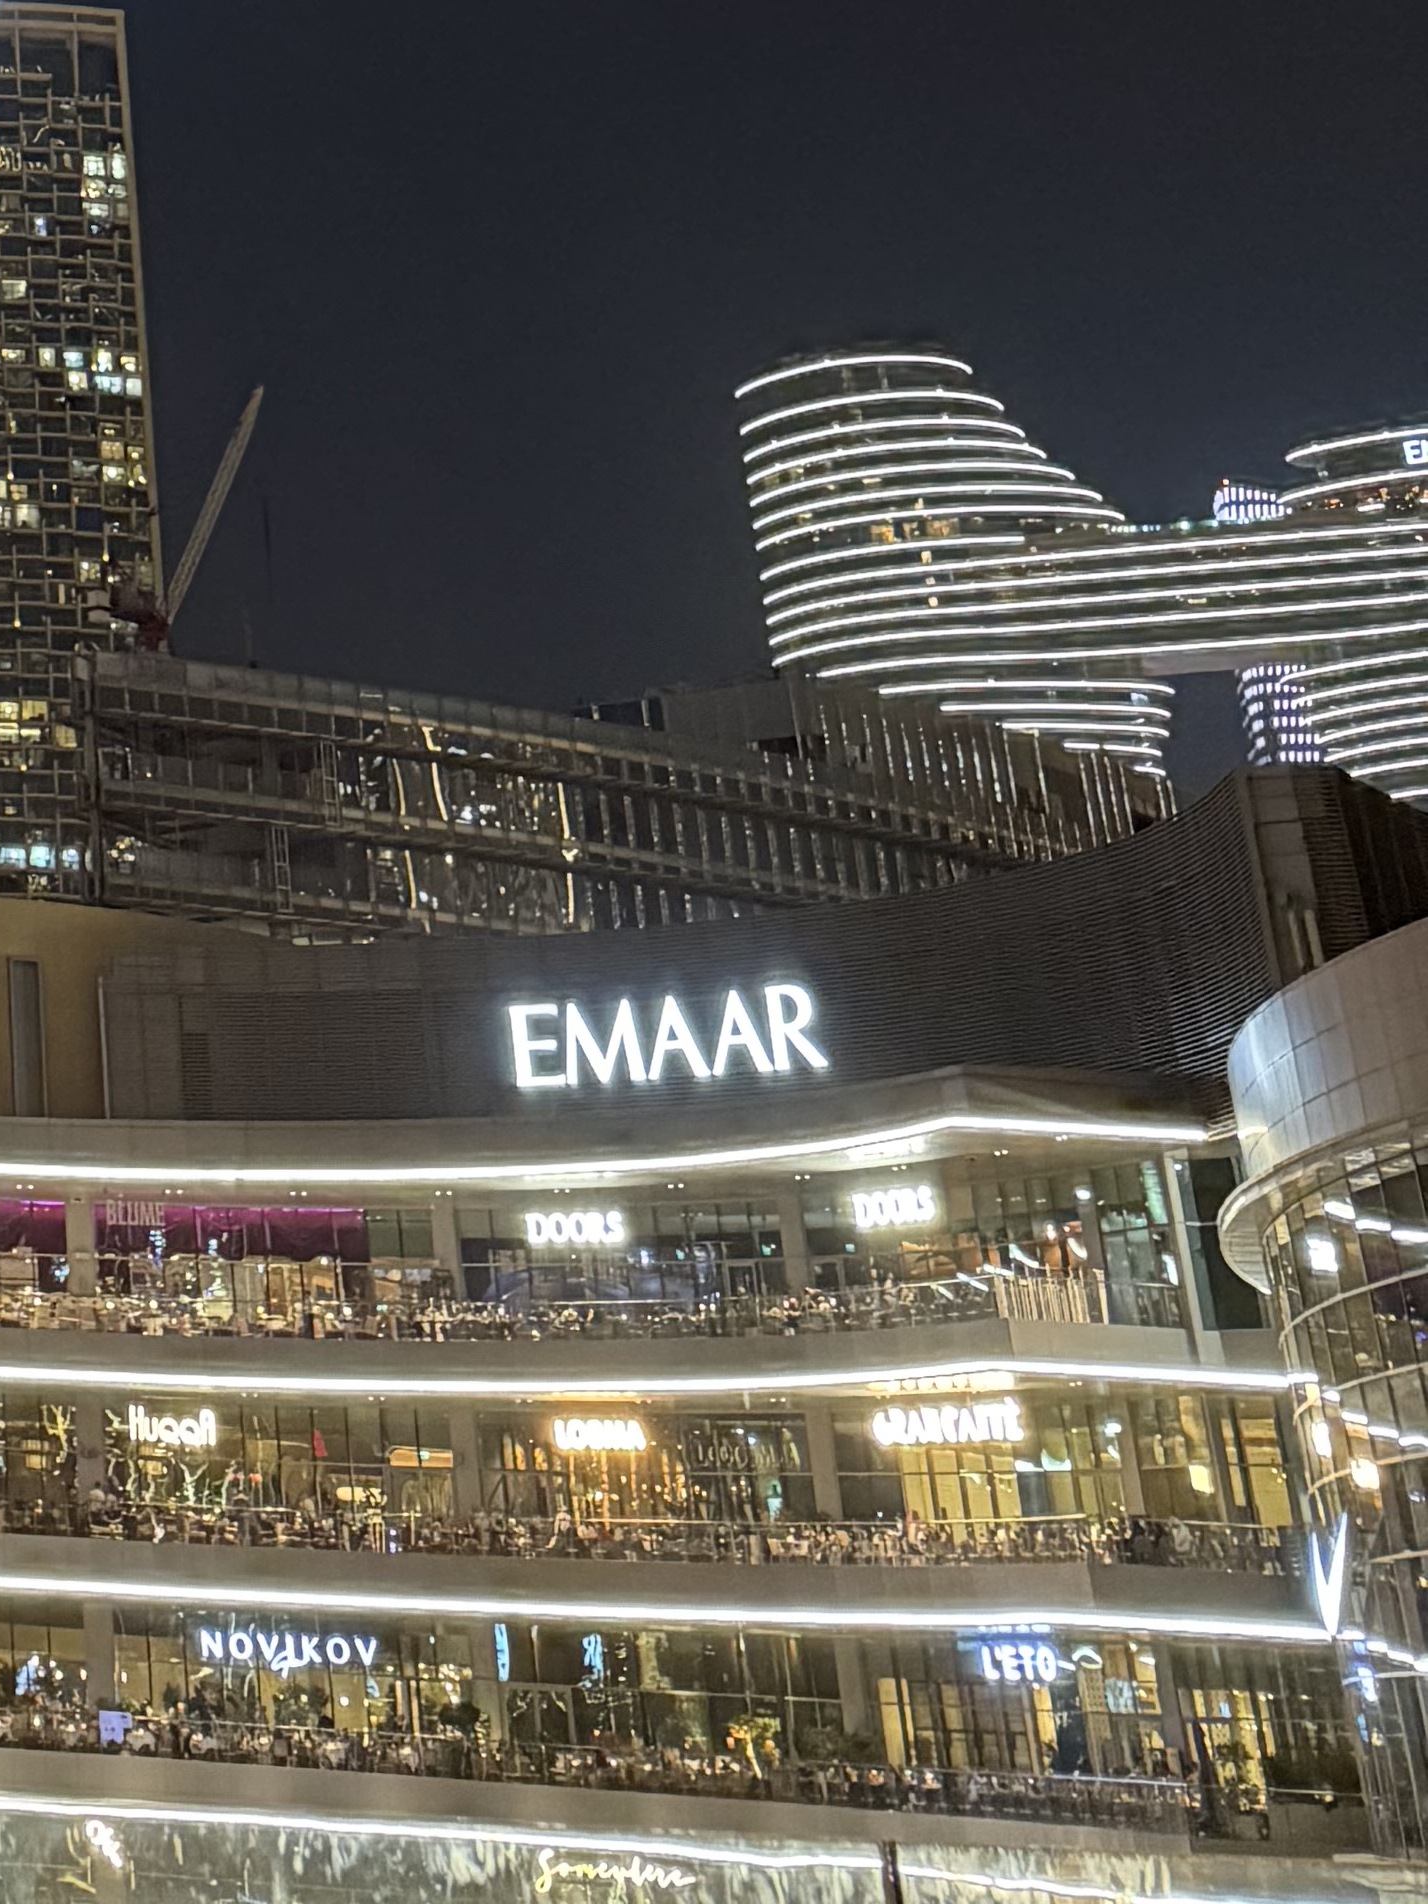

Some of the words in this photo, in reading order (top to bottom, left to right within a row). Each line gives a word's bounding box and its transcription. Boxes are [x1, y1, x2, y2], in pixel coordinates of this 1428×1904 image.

[508, 983, 830, 1088] EMAAR
[105, 1199, 166, 1226] BLUME
[524, 1210, 625, 1243] DOORS
